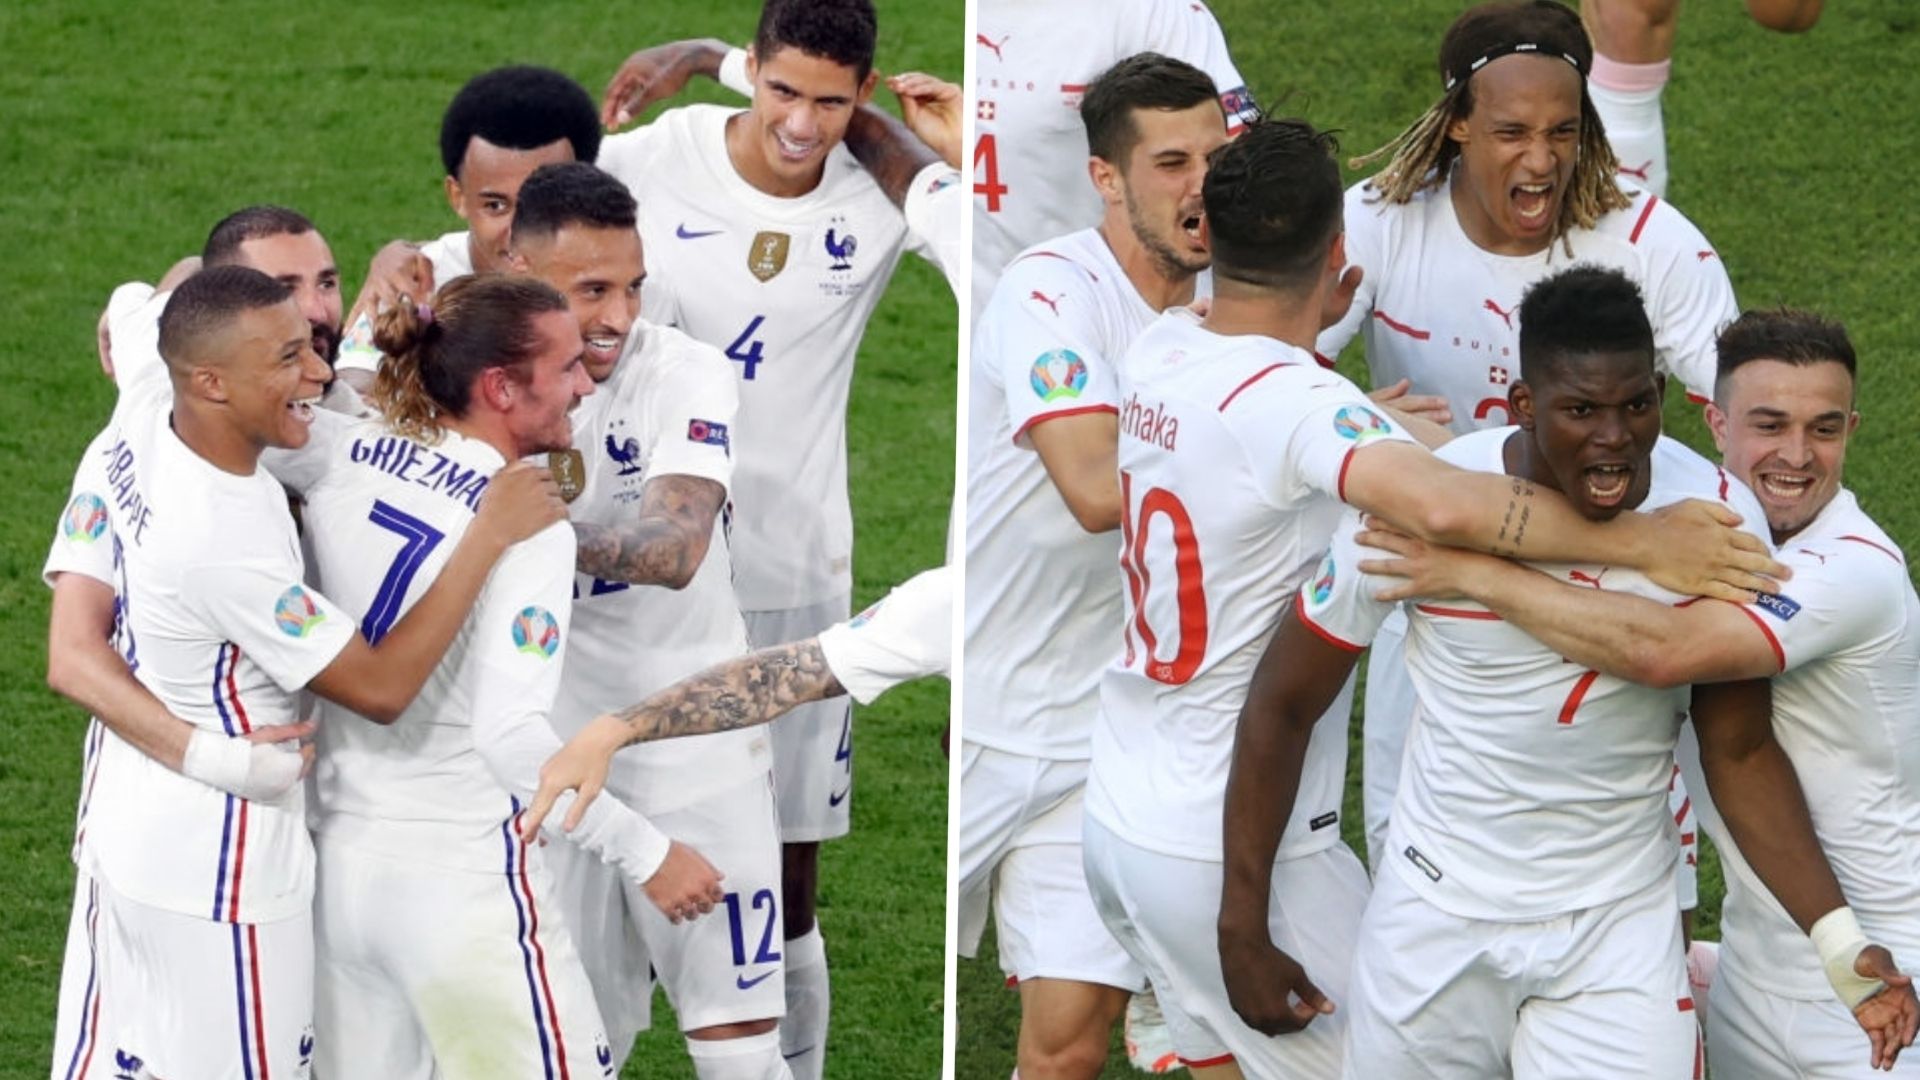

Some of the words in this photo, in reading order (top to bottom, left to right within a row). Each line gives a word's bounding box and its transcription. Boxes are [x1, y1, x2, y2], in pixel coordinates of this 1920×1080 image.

[973, 133, 1008, 212] 4
[725, 315, 766, 381] 4
[350, 437, 489, 513] GRIEZMA
[360, 498, 446, 649] 7
[1119, 469, 1208, 686] 10
[720, 888, 782, 967] 12
